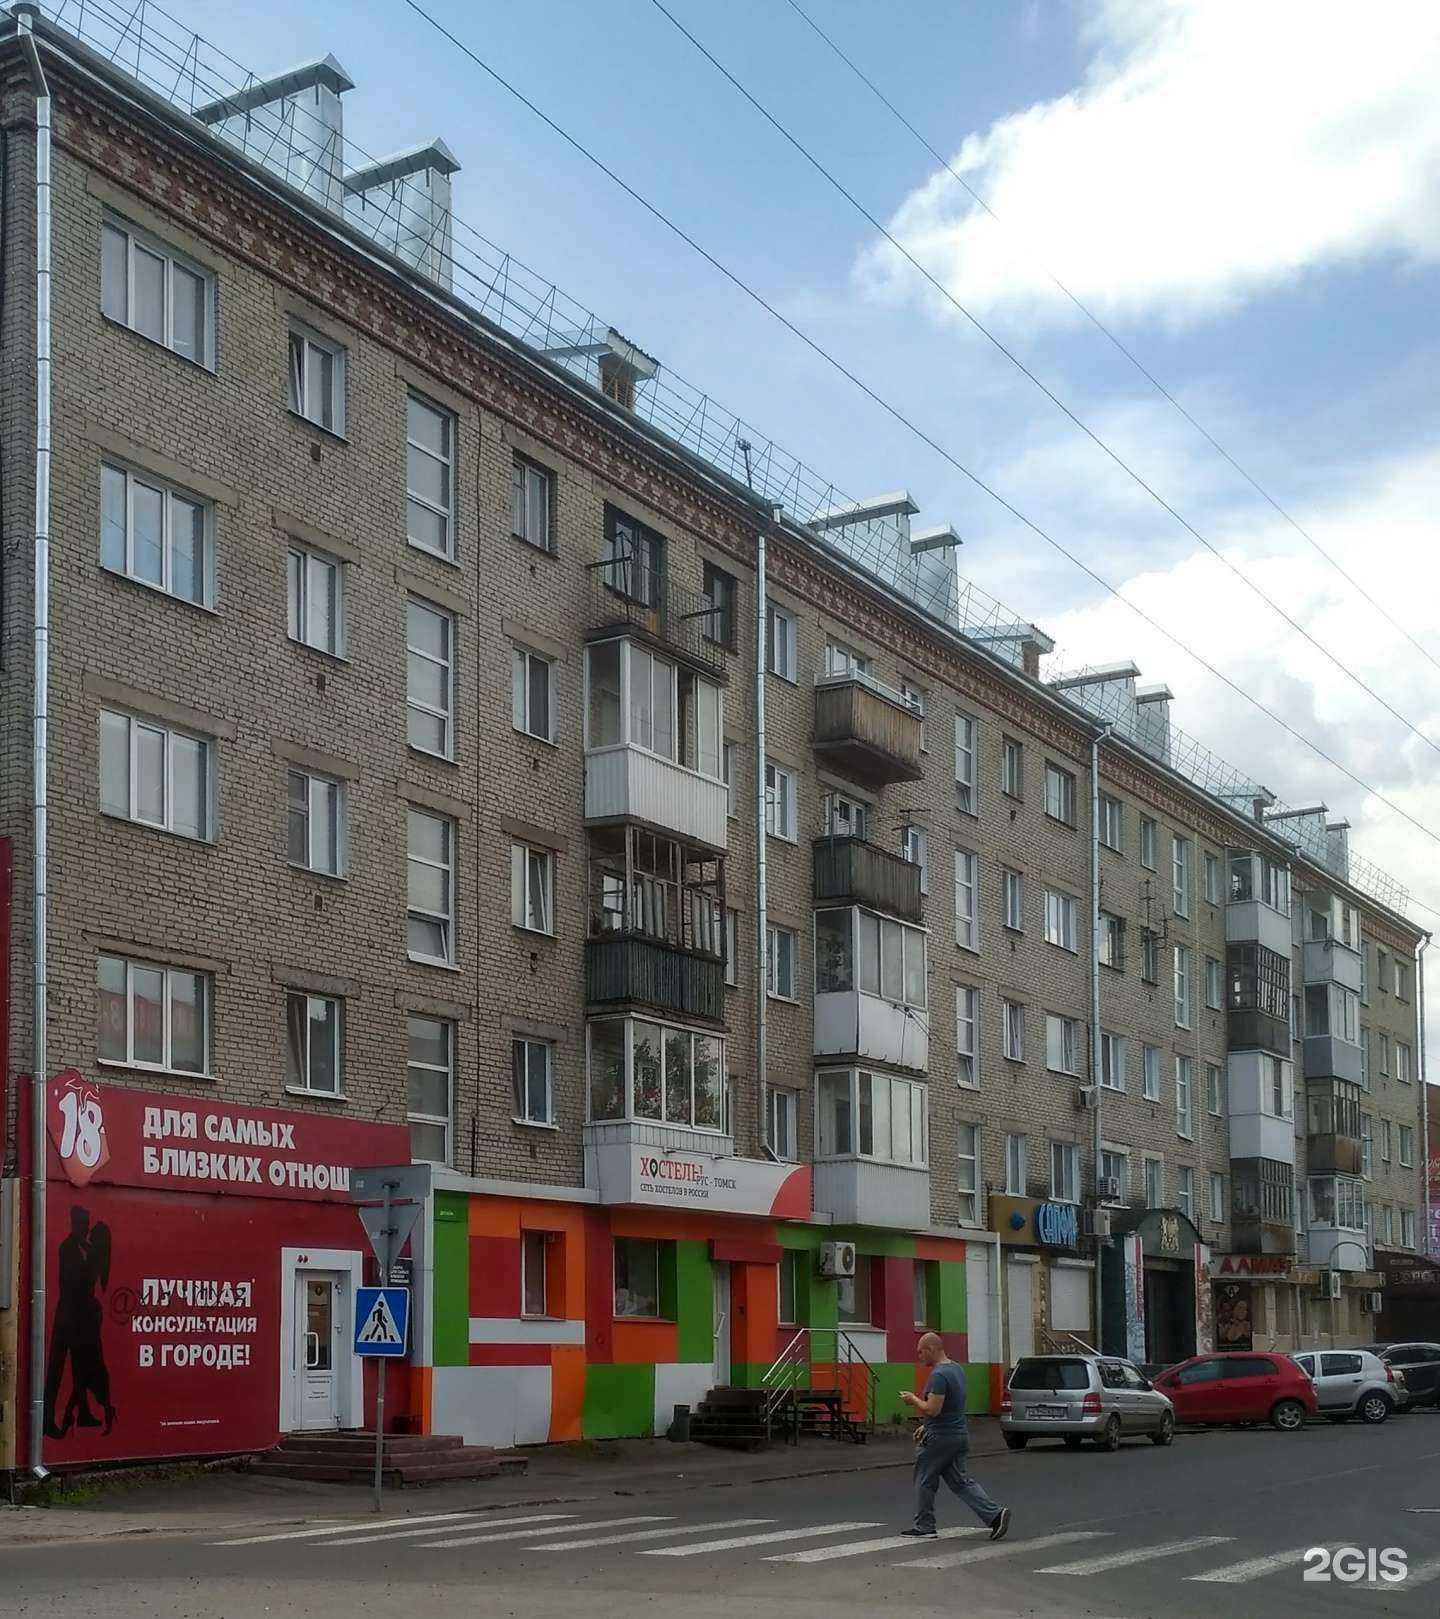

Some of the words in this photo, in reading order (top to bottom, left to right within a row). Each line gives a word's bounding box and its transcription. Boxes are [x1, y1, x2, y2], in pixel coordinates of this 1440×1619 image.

[59, 1091, 103, 1167] 18
[143, 1106, 198, 1139] ДЛЯ
[204, 1114, 296, 1150] САМЫХ
[143, 1146, 263, 1184] БЛИЗКИХ
[714, 1177, 736, 1190] ТОМСК
[140, 1278, 252, 1308] ЛУЧШАЯ
[131, 1315, 257, 1335] КОНСУЛЬТАЦИЯ
[139, 1344, 154, 1368] В
[161, 1344, 251, 1370] ГОРОДЕ!
